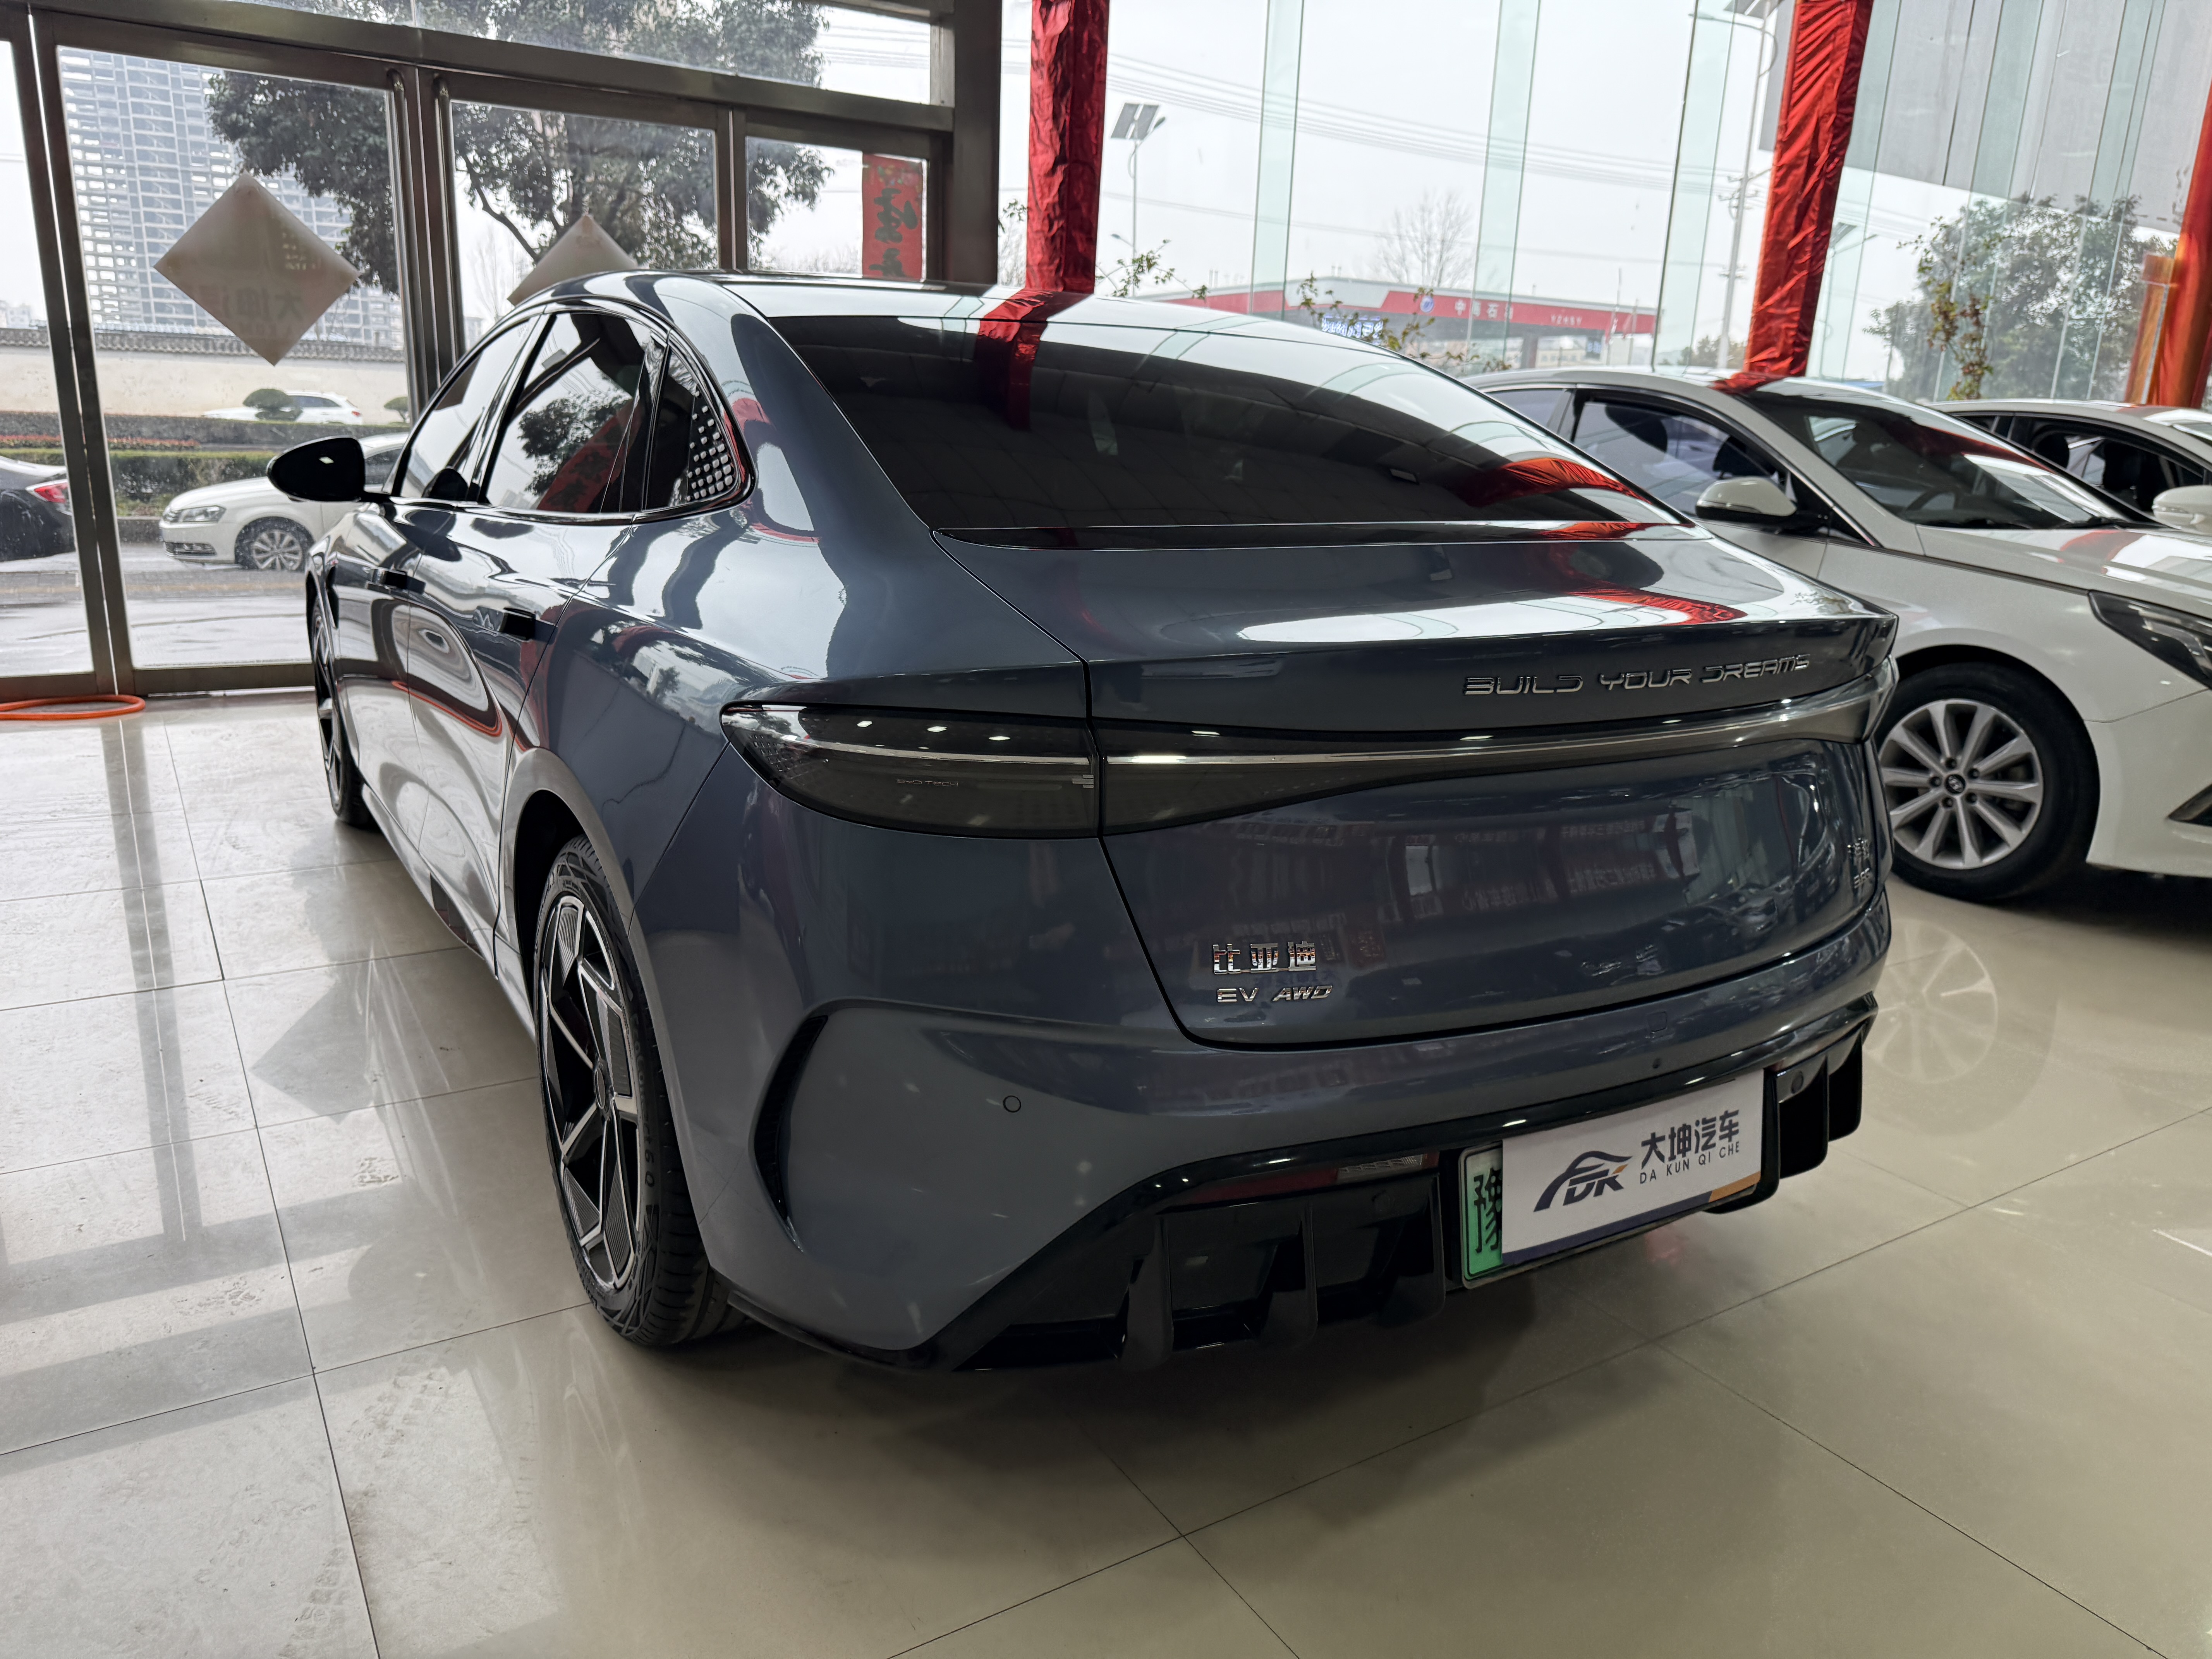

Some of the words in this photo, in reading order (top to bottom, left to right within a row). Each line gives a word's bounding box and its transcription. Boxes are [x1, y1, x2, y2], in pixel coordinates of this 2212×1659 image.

[1463, 676, 1583, 696] BUILD
[1600, 668, 1692, 690] YOUR
[1702, 653, 1811, 683] DREAMS
[1212, 941, 1317, 975] 比亚迪
[1217, 988, 1259, 1003] EV
[1272, 986, 1333, 1002] AWD
[1641, 1109, 1739, 1169] 大坤汽车
[1640, 1169, 1657, 1185] DA
[1666, 1158, 1689, 1176] KUN
[1698, 1151, 1710, 1165] QI
[1719, 1141, 1740, 1158] CHE
